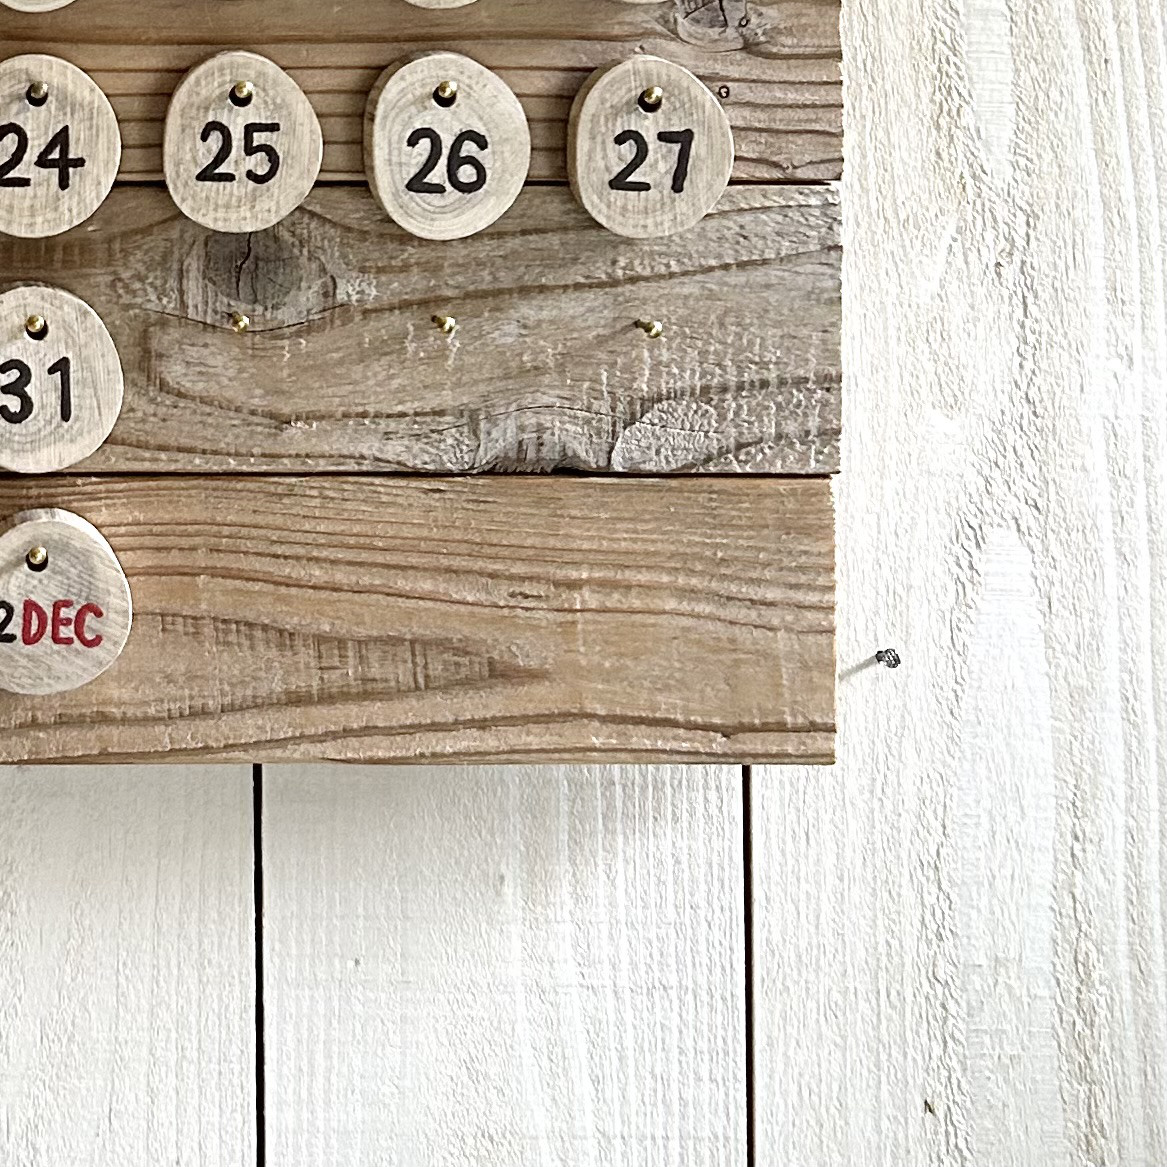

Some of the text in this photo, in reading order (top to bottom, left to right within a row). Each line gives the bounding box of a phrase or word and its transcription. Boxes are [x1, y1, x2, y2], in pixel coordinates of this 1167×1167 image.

[196, 121, 280, 184] 25
[406, 128, 488, 194] 26
[608, 129, 694, 193] 27
